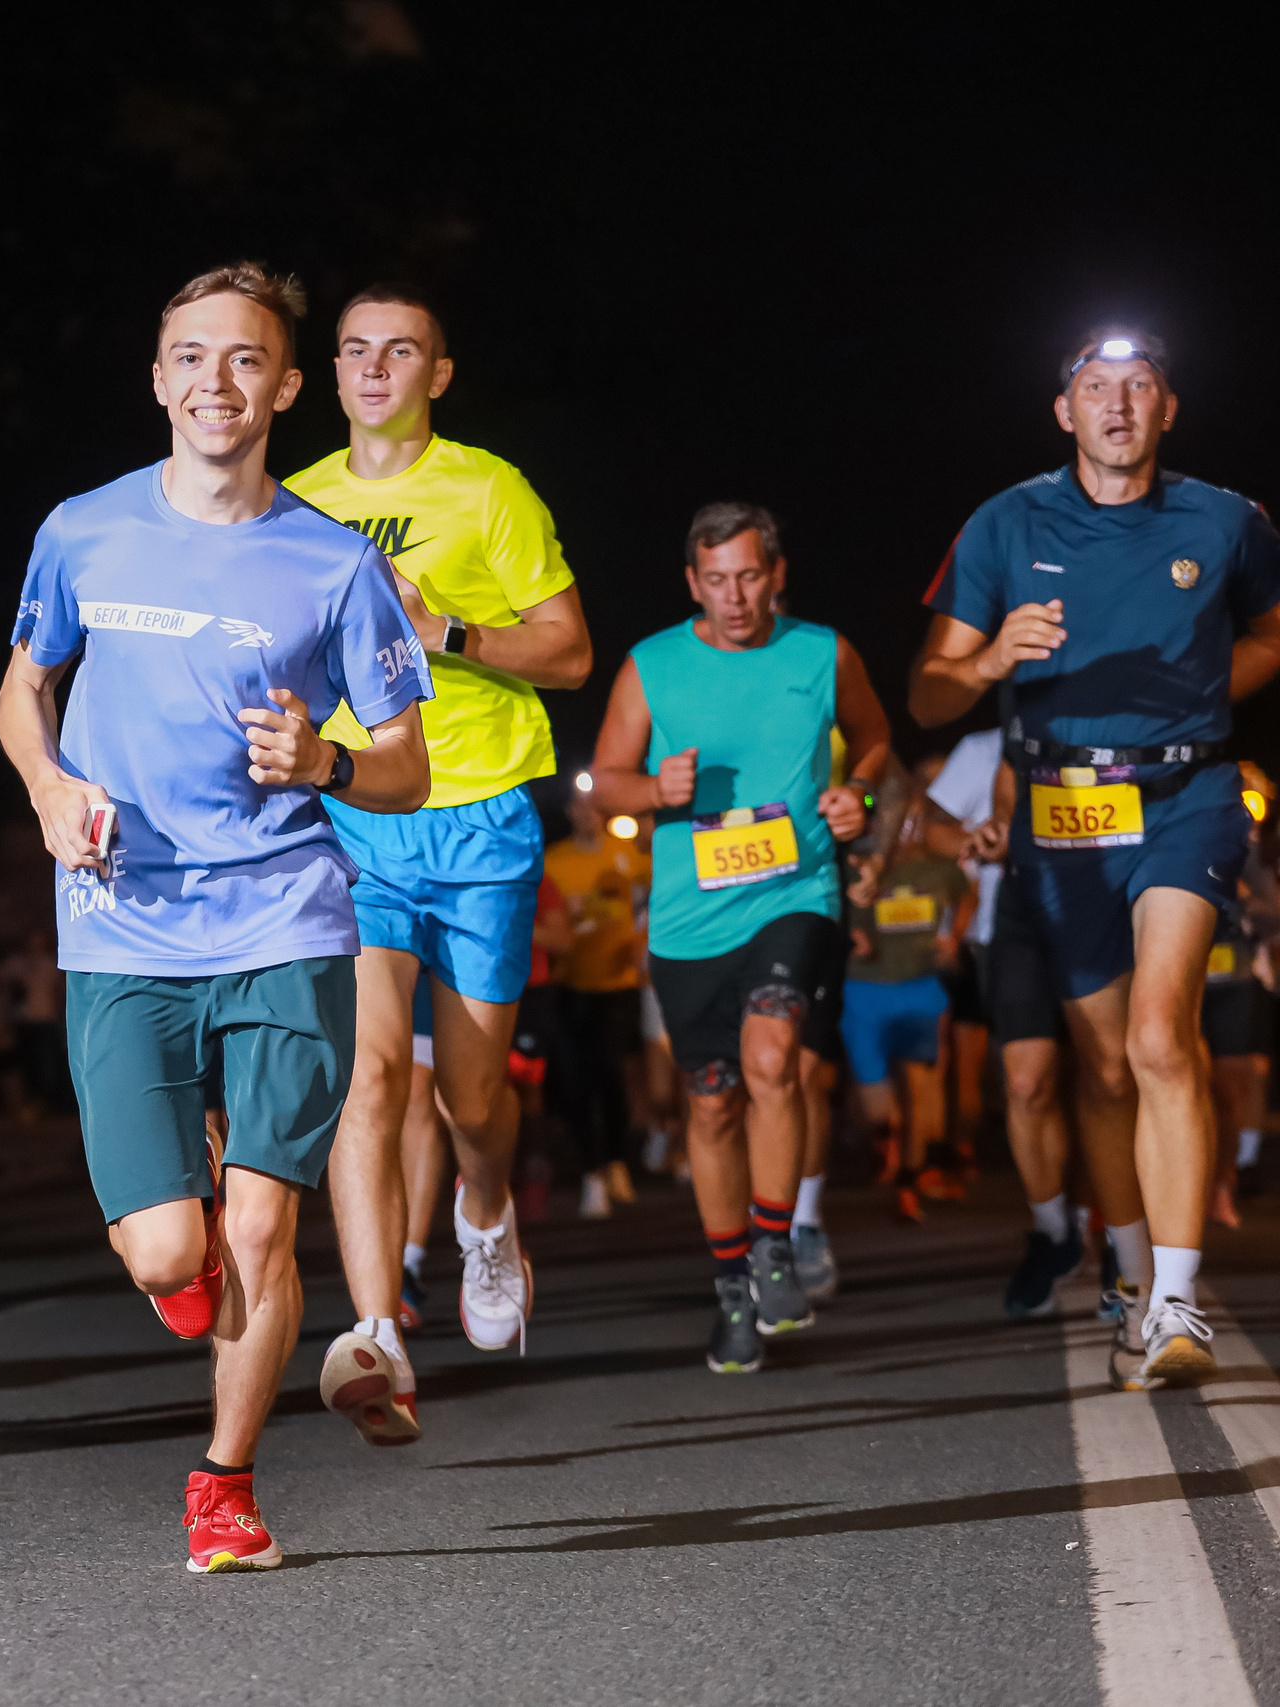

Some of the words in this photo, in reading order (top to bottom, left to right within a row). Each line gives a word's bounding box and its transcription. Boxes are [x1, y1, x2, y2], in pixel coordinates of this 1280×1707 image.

[93, 607, 129, 627] БЕГИ,
[135, 610, 186, 632] ГЕРОЙ!
[1048, 803, 1117, 835] 5362
[713, 838, 776, 874] 5563
[68, 881, 117, 922] RUN
